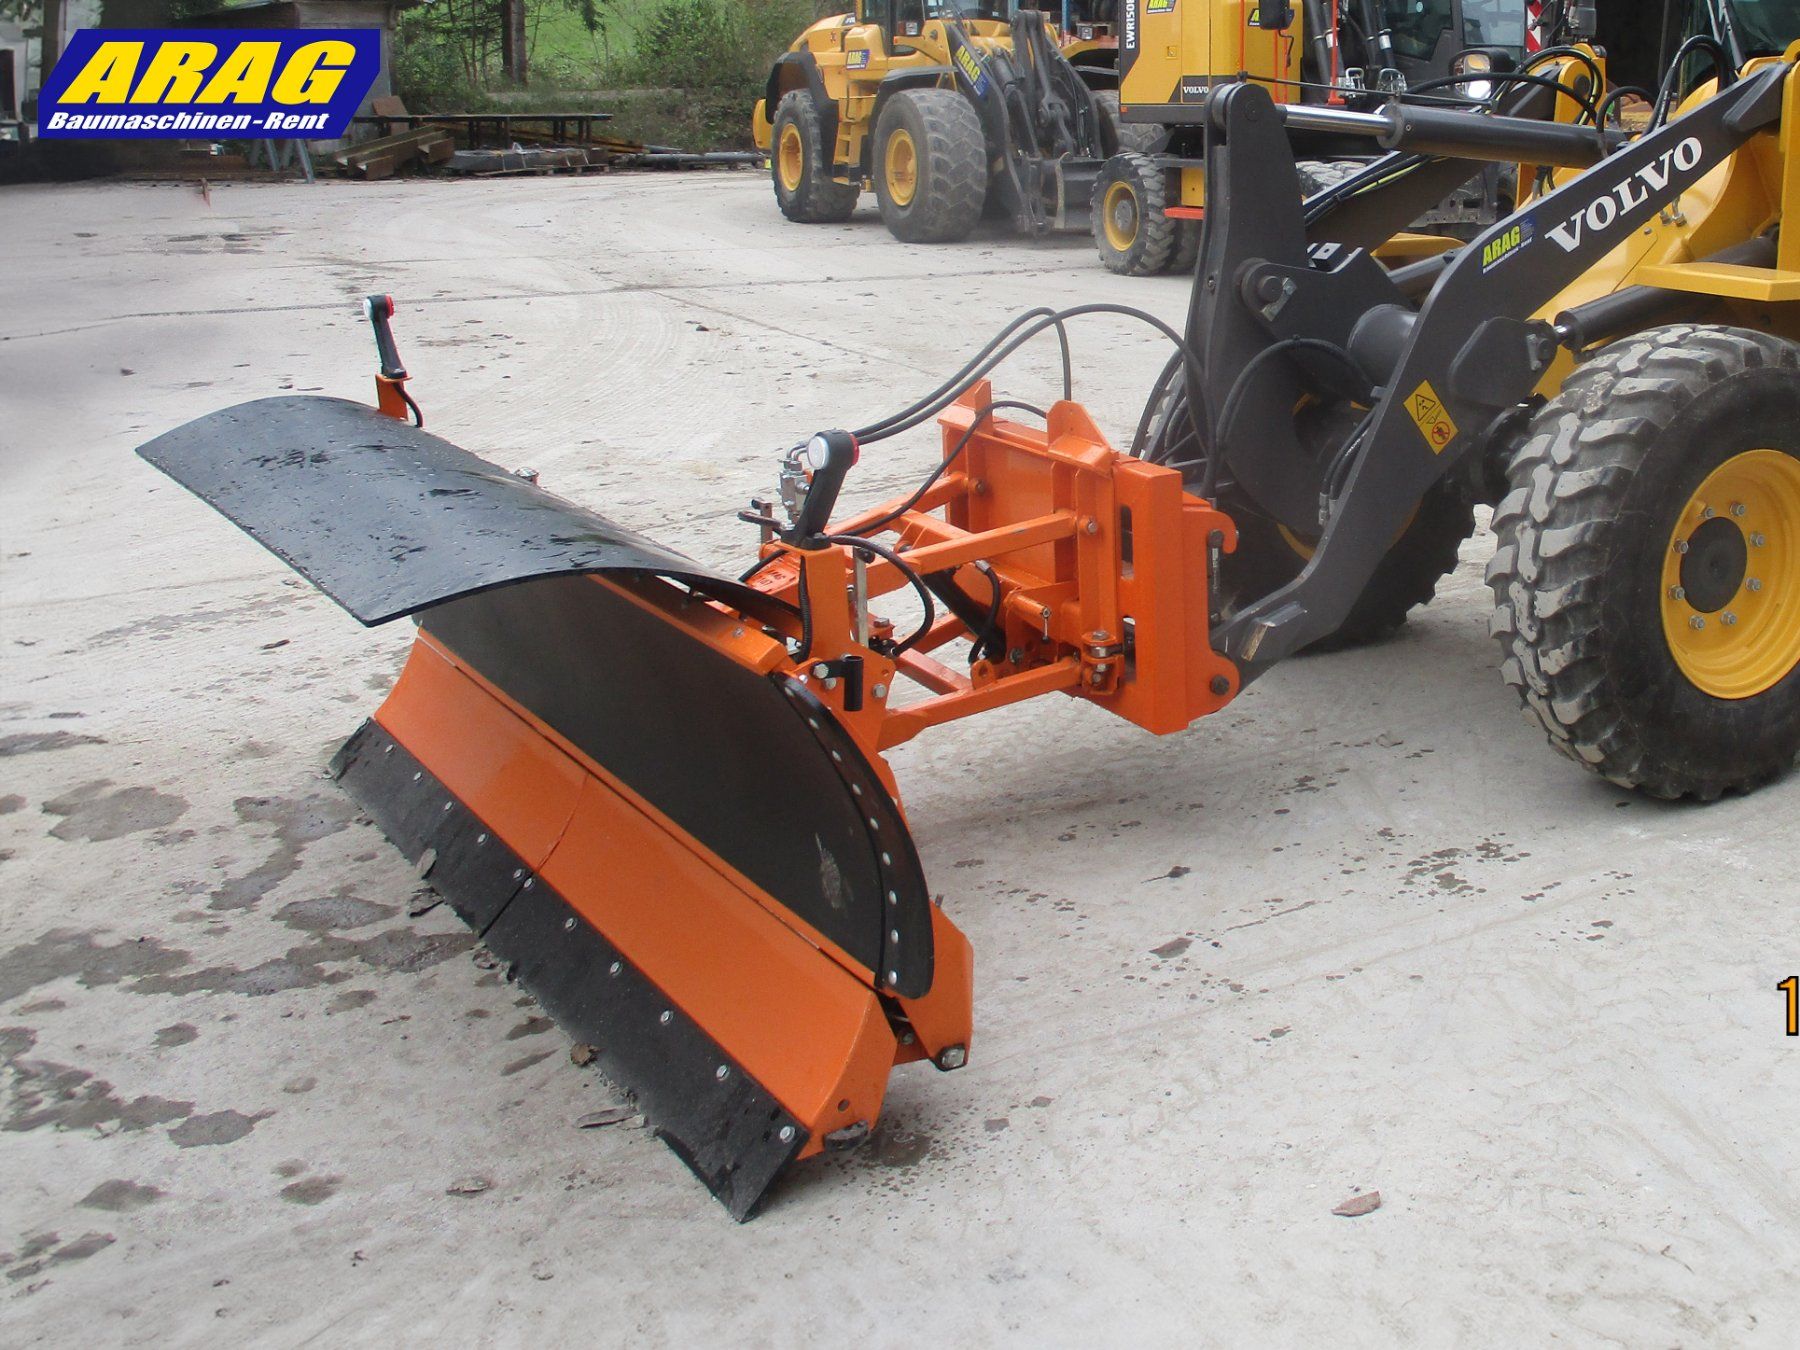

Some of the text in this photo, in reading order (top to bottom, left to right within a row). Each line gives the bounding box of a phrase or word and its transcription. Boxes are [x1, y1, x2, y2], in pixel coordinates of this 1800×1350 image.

[955, 45, 980, 82] ARAG
[1183, 86, 1209, 94] VOLVO
[1544, 137, 1702, 253] VOLVO
[1482, 225, 1521, 268] ARAG
